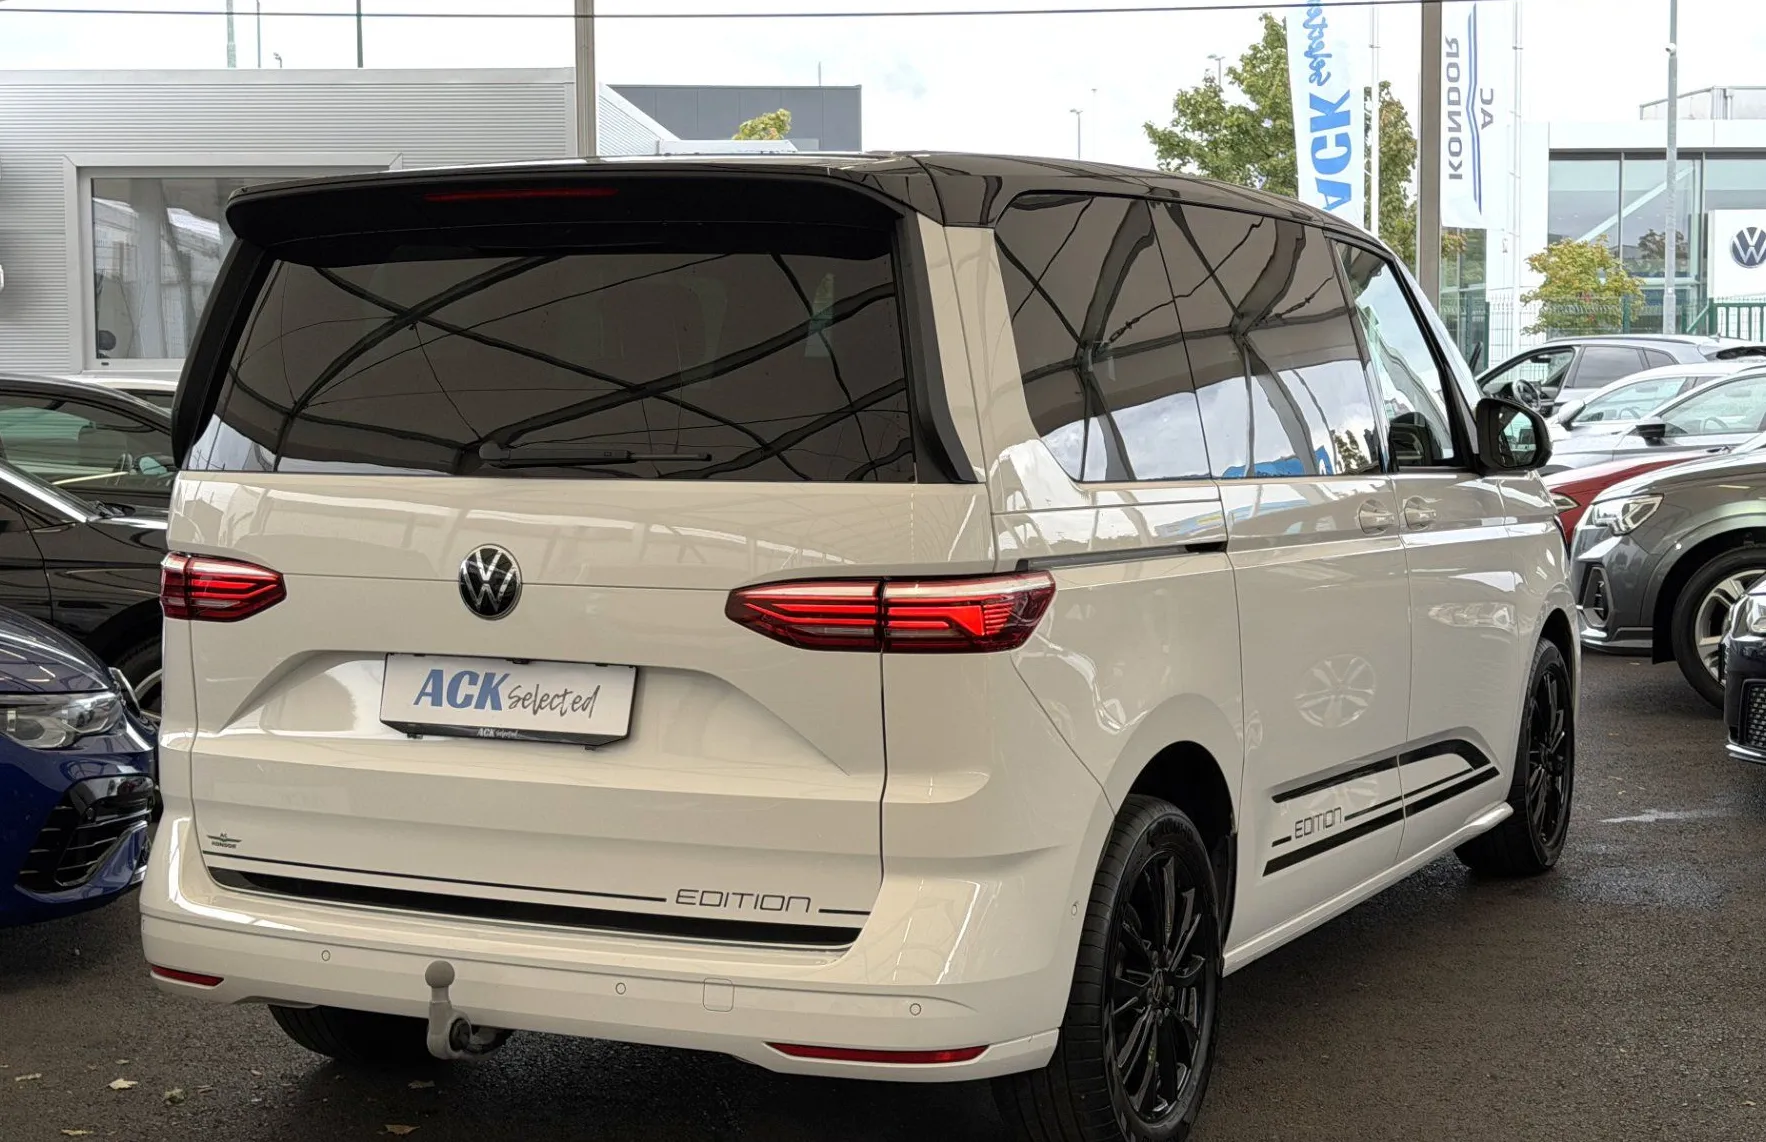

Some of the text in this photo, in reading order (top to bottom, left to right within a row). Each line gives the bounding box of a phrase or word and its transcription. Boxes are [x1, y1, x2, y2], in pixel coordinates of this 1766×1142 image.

[413, 668, 601, 719] ACK Selected
[1294, 806, 1342, 839] EDITION
[675, 888, 812, 913] EDITION
